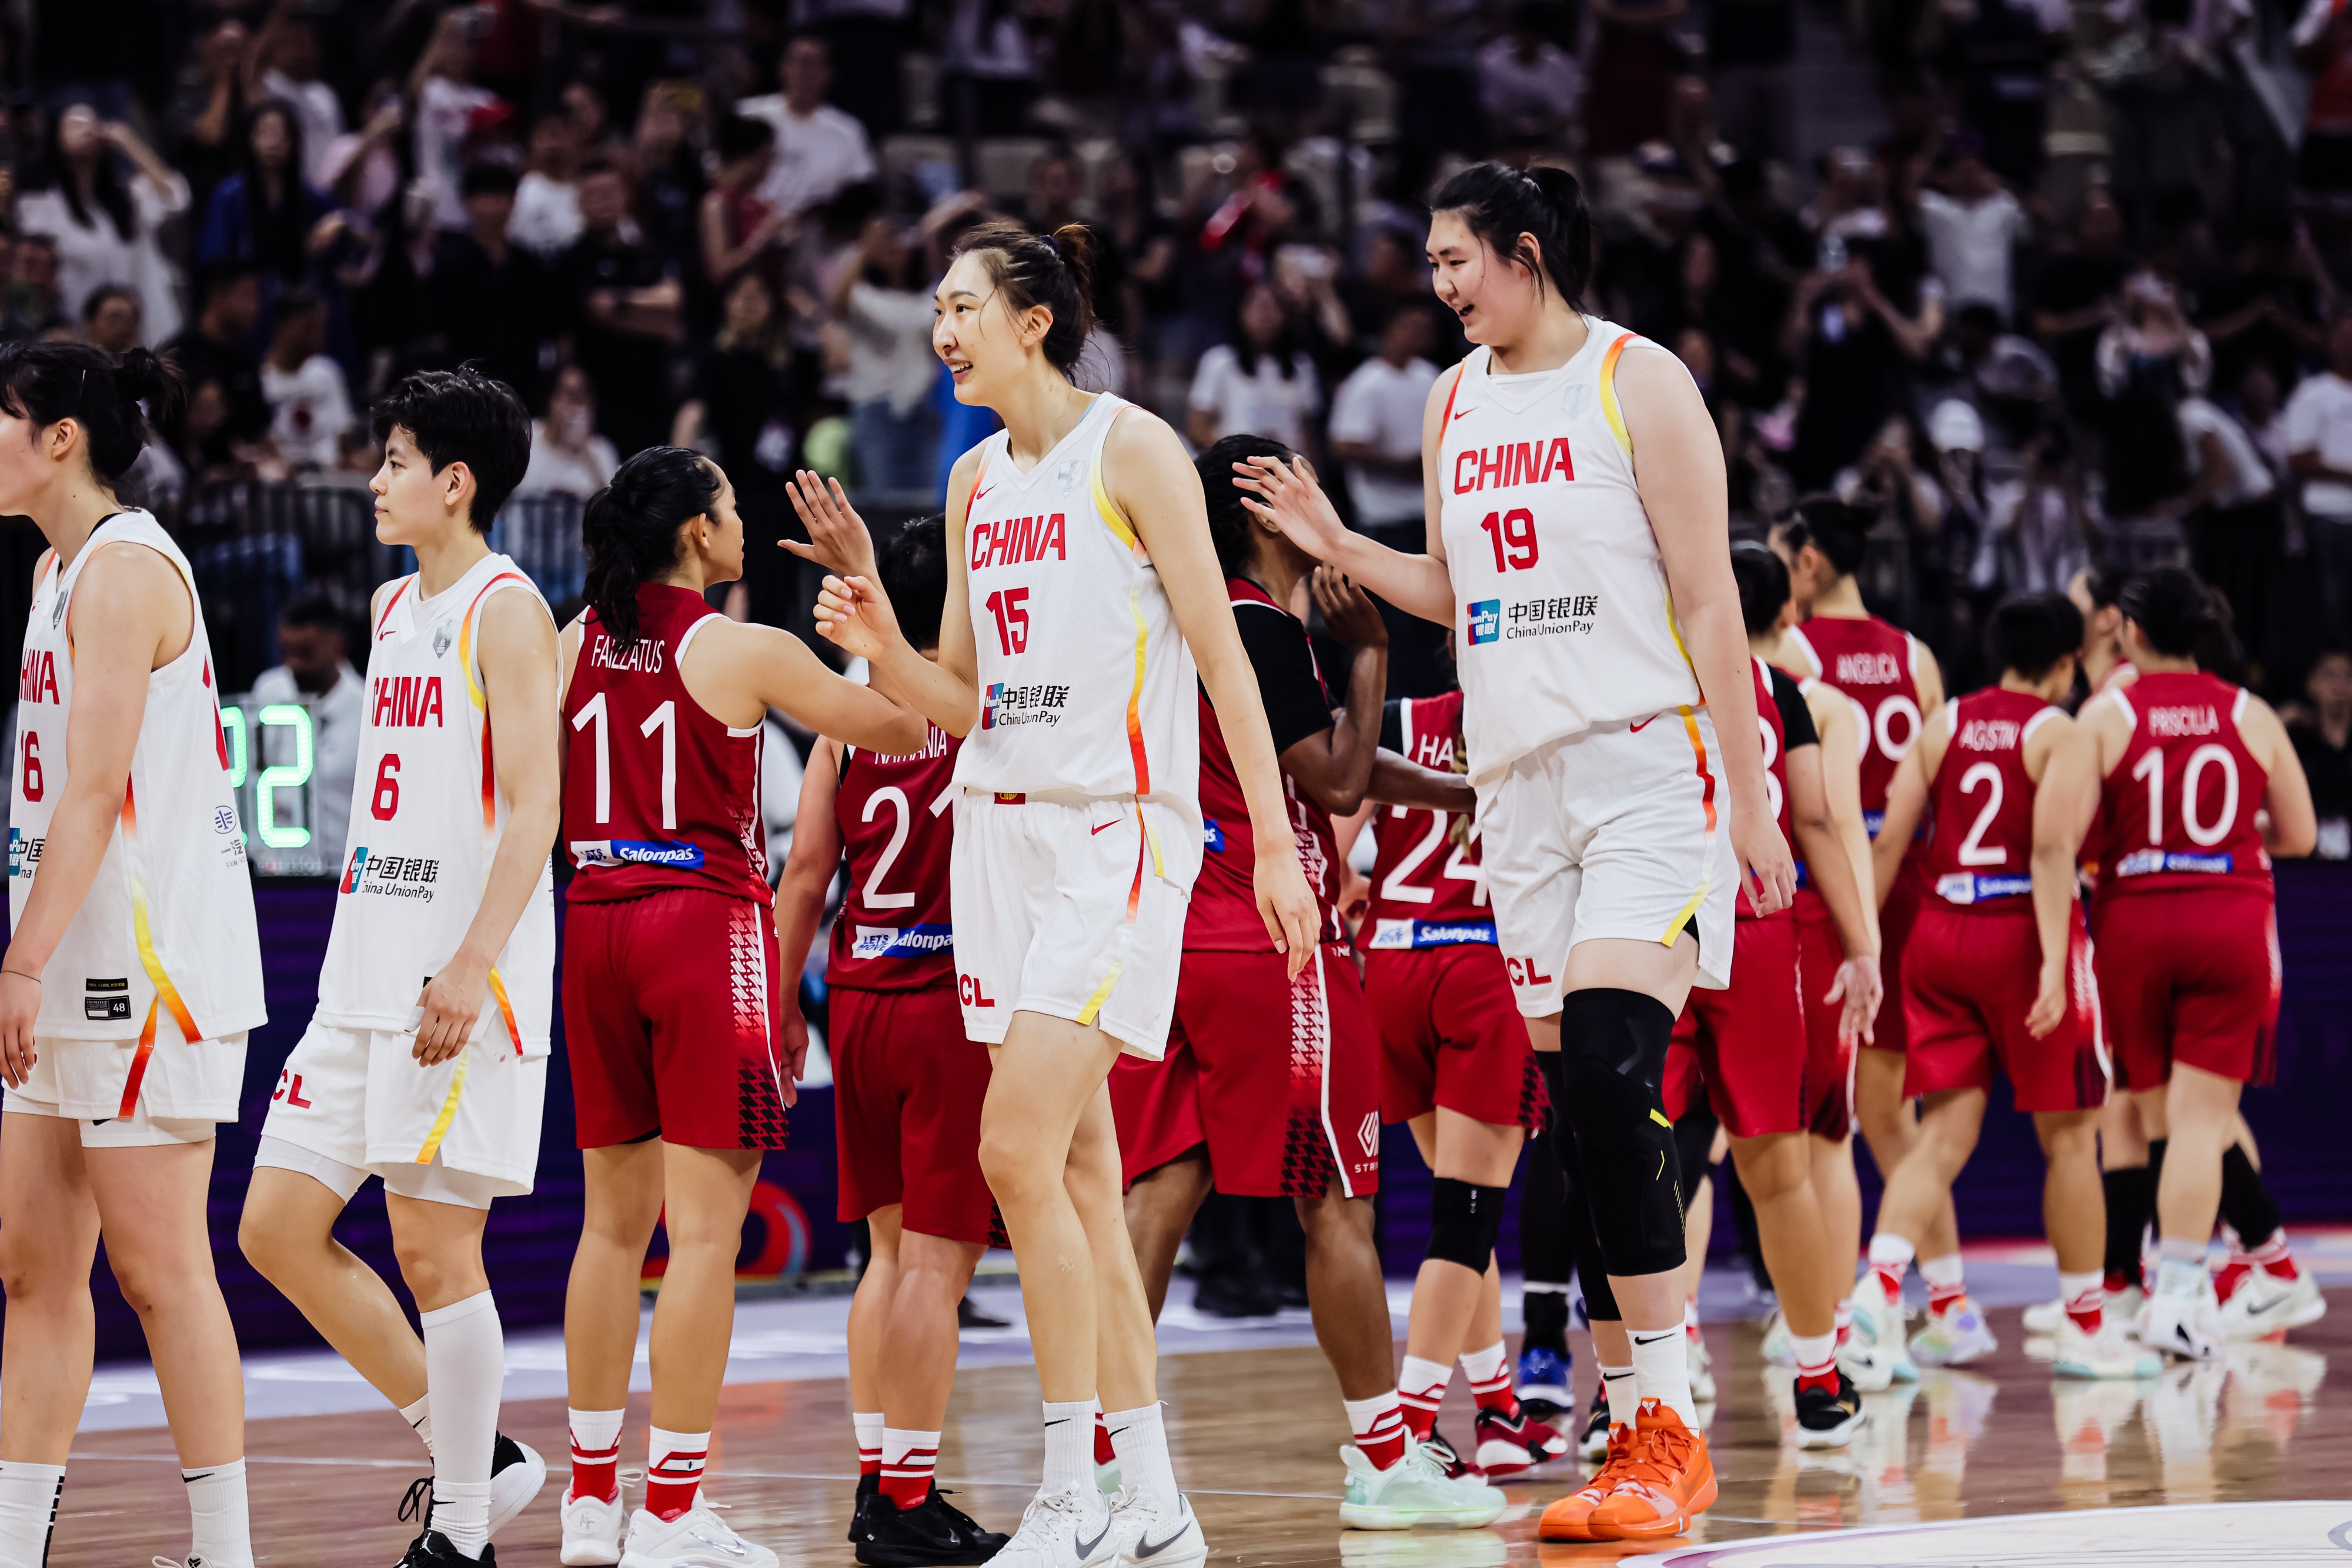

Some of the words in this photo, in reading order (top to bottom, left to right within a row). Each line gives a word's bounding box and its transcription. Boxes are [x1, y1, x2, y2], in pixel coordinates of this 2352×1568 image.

[1454, 437, 1575, 495] CHINA
[971, 513, 1066, 571] CHINA
[1481, 508, 1539, 573] 19
[985, 587, 1029, 656] 15
[1468, 610, 1499, 625] UnionPay
[1508, 596, 1598, 623] 中国银联
[999, 713, 1021, 726] China
[1002, 686, 1070, 710] 中国银联
[572, 693, 677, 830] 11
[371, 753, 400, 821] 6
[2132, 743, 2239, 846] 10
[1958, 762, 2007, 865] 2
[366, 855, 440, 883] 中国银联
[1380, 804, 1489, 907] 24
[385, 882, 435, 903] UnionPay
[893, 931, 953, 951] alonpa
[1419, 925, 1491, 942] Salonpas
[113, 1003, 125, 1012] 48
